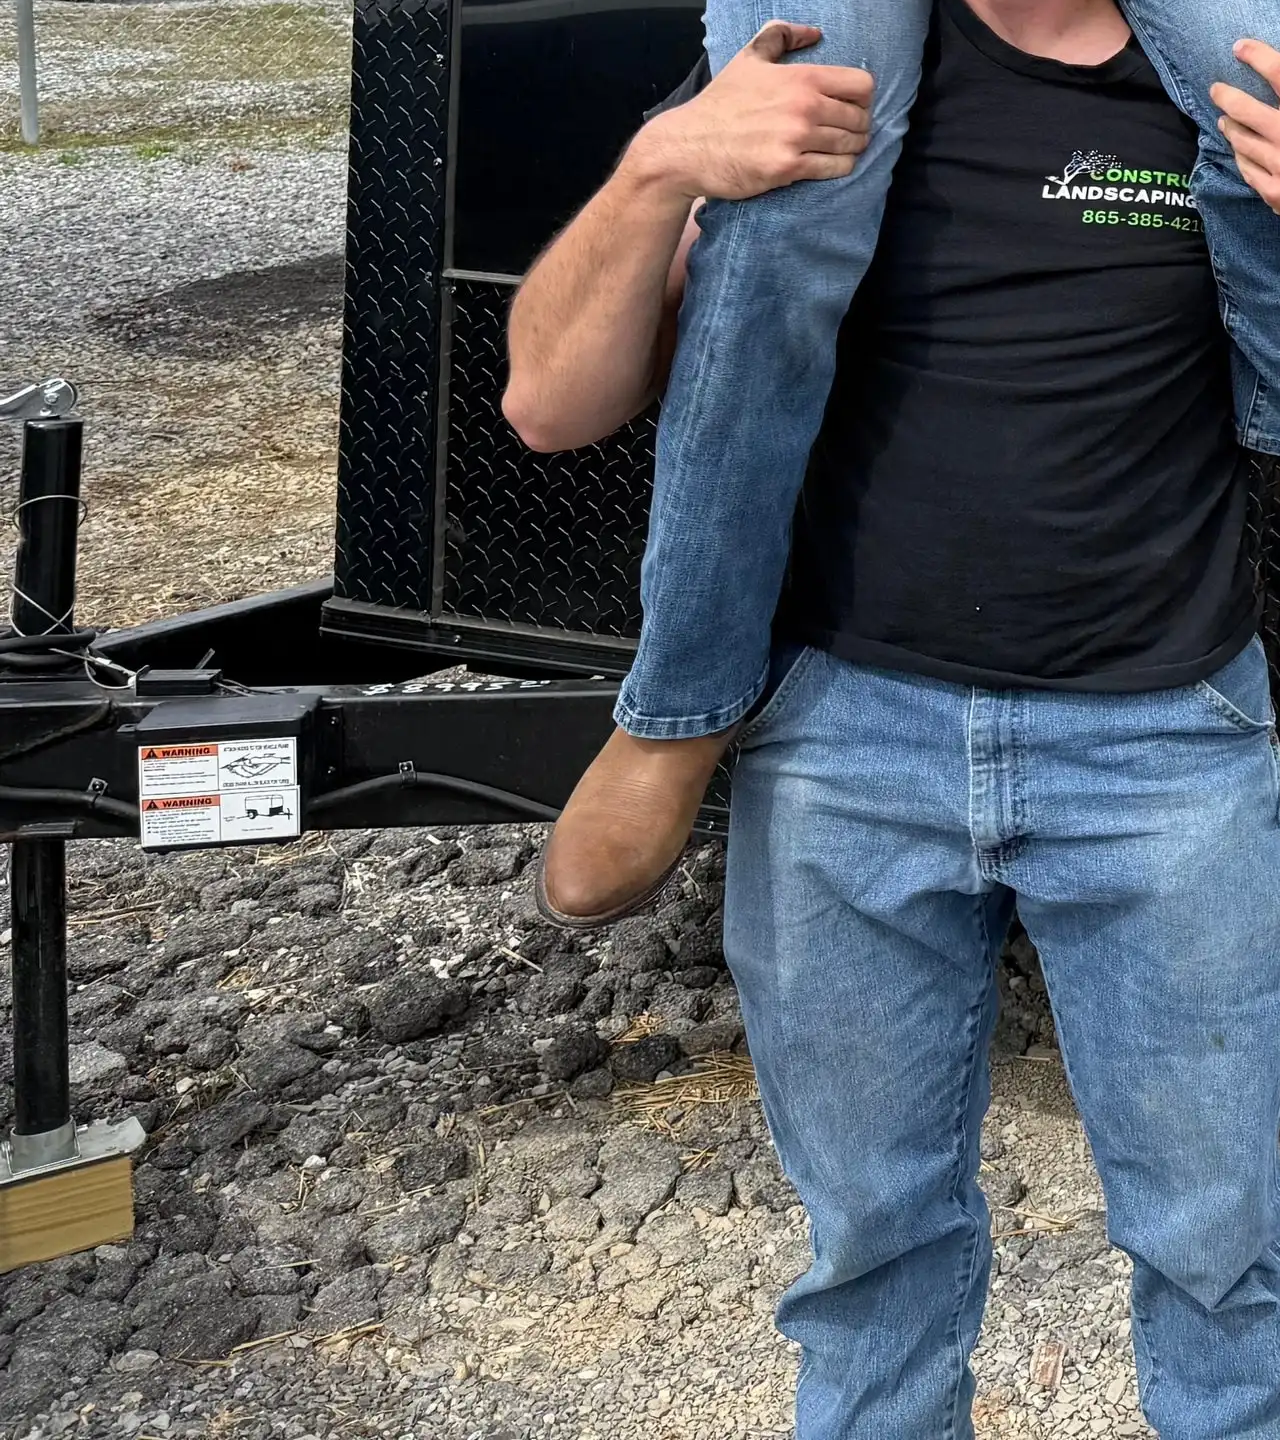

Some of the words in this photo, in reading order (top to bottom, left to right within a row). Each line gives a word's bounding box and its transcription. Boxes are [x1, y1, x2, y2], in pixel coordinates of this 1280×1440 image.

[1042, 185, 1197, 209] LANDSCAPING
[1081, 210, 1205, 233] 865-385-421
[161, 747, 211, 758] WARNING
[161, 797, 212, 808] WARNING
